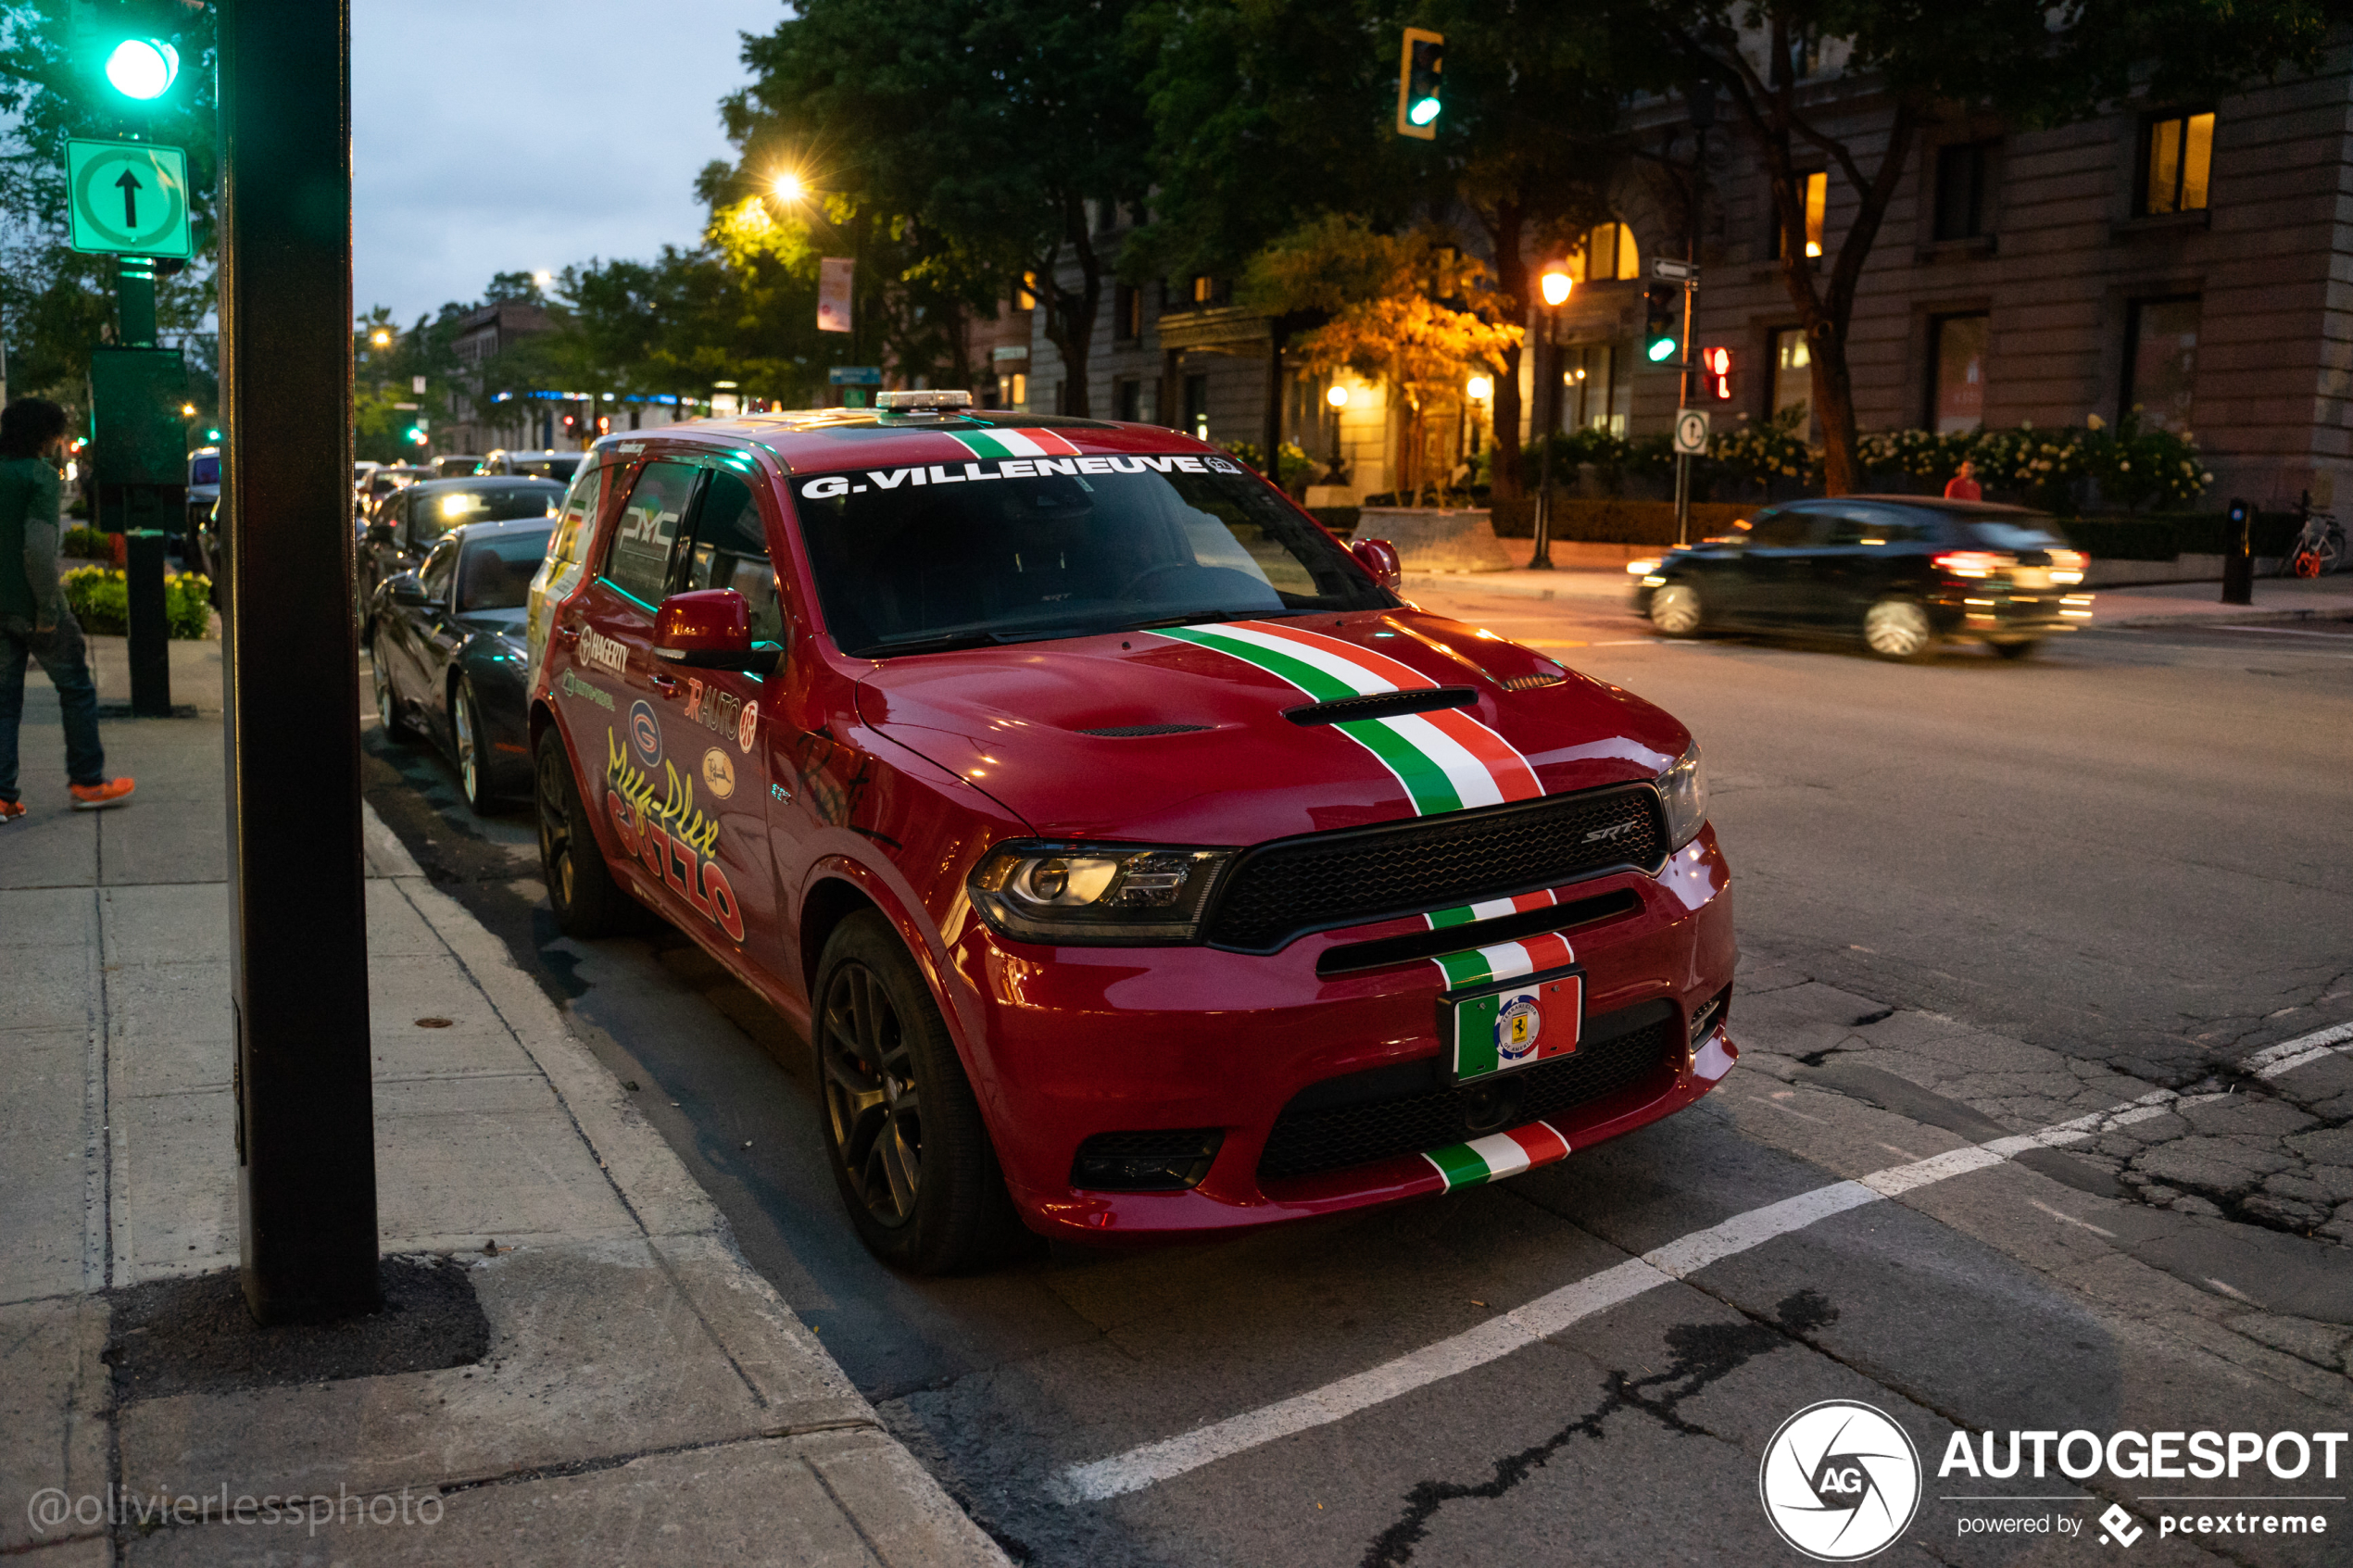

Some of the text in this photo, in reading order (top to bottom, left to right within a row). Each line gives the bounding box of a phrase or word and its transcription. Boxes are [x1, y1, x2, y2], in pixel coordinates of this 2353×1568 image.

[591, 633, 630, 673] HAGERTY
[1580, 821, 1638, 845] SRT
[608, 789, 745, 943] GUZZO
[1502, 1003, 1537, 1022] FERRARI CLUB
[1512, 1035, 1535, 1051] AMERICA
